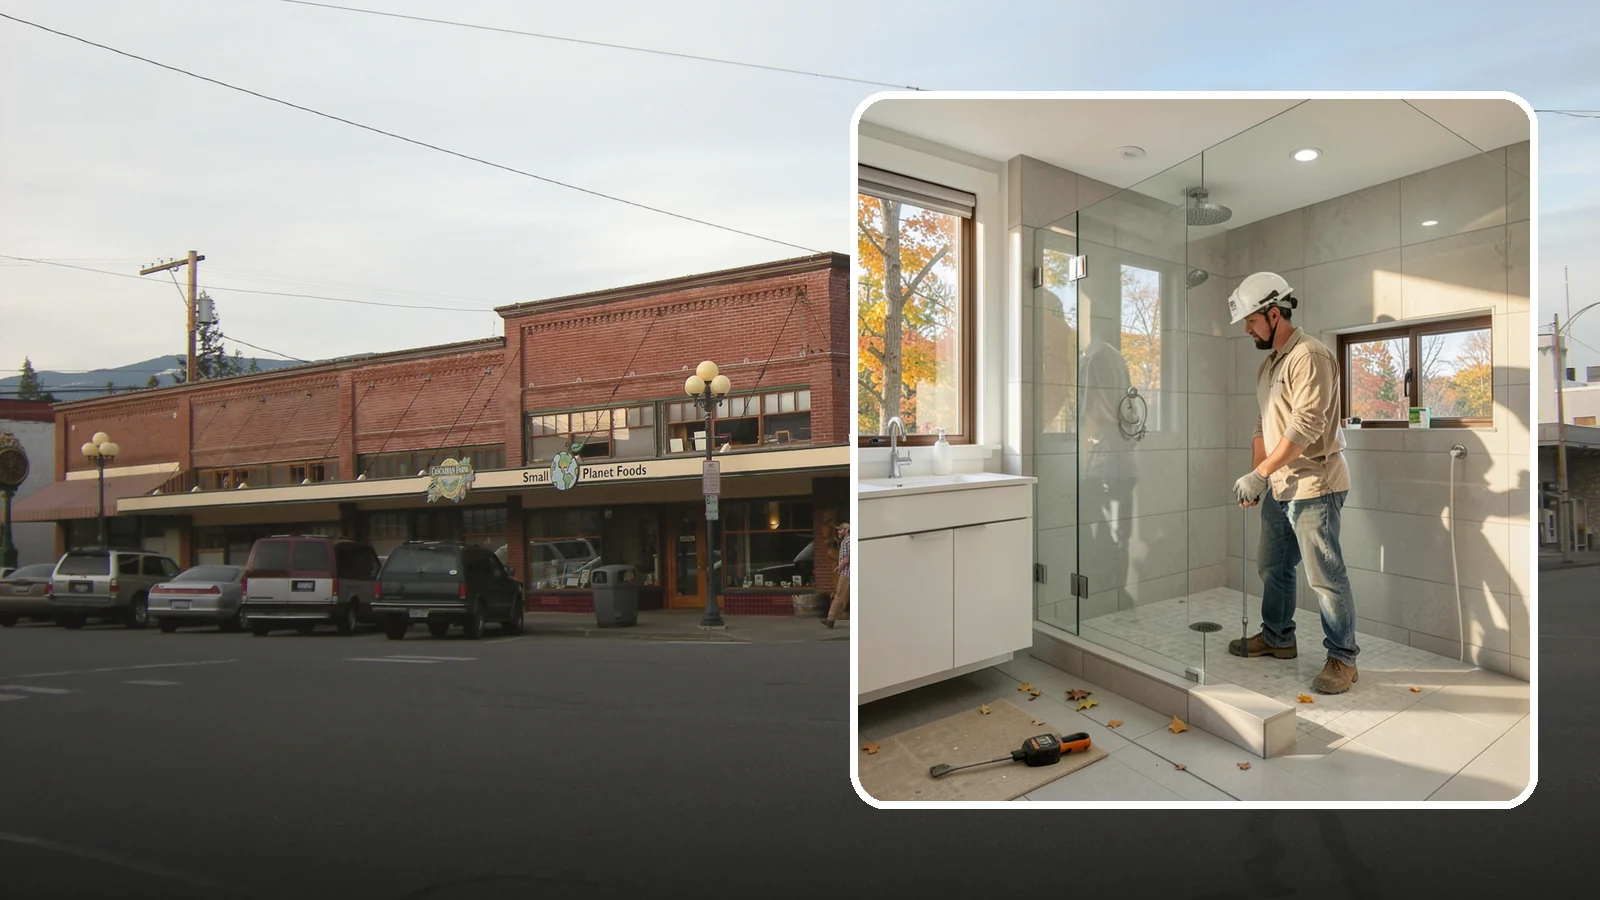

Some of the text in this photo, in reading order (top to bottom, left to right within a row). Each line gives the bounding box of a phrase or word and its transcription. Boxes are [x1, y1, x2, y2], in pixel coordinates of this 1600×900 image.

[523, 464, 647, 482] Small Planet Foods
